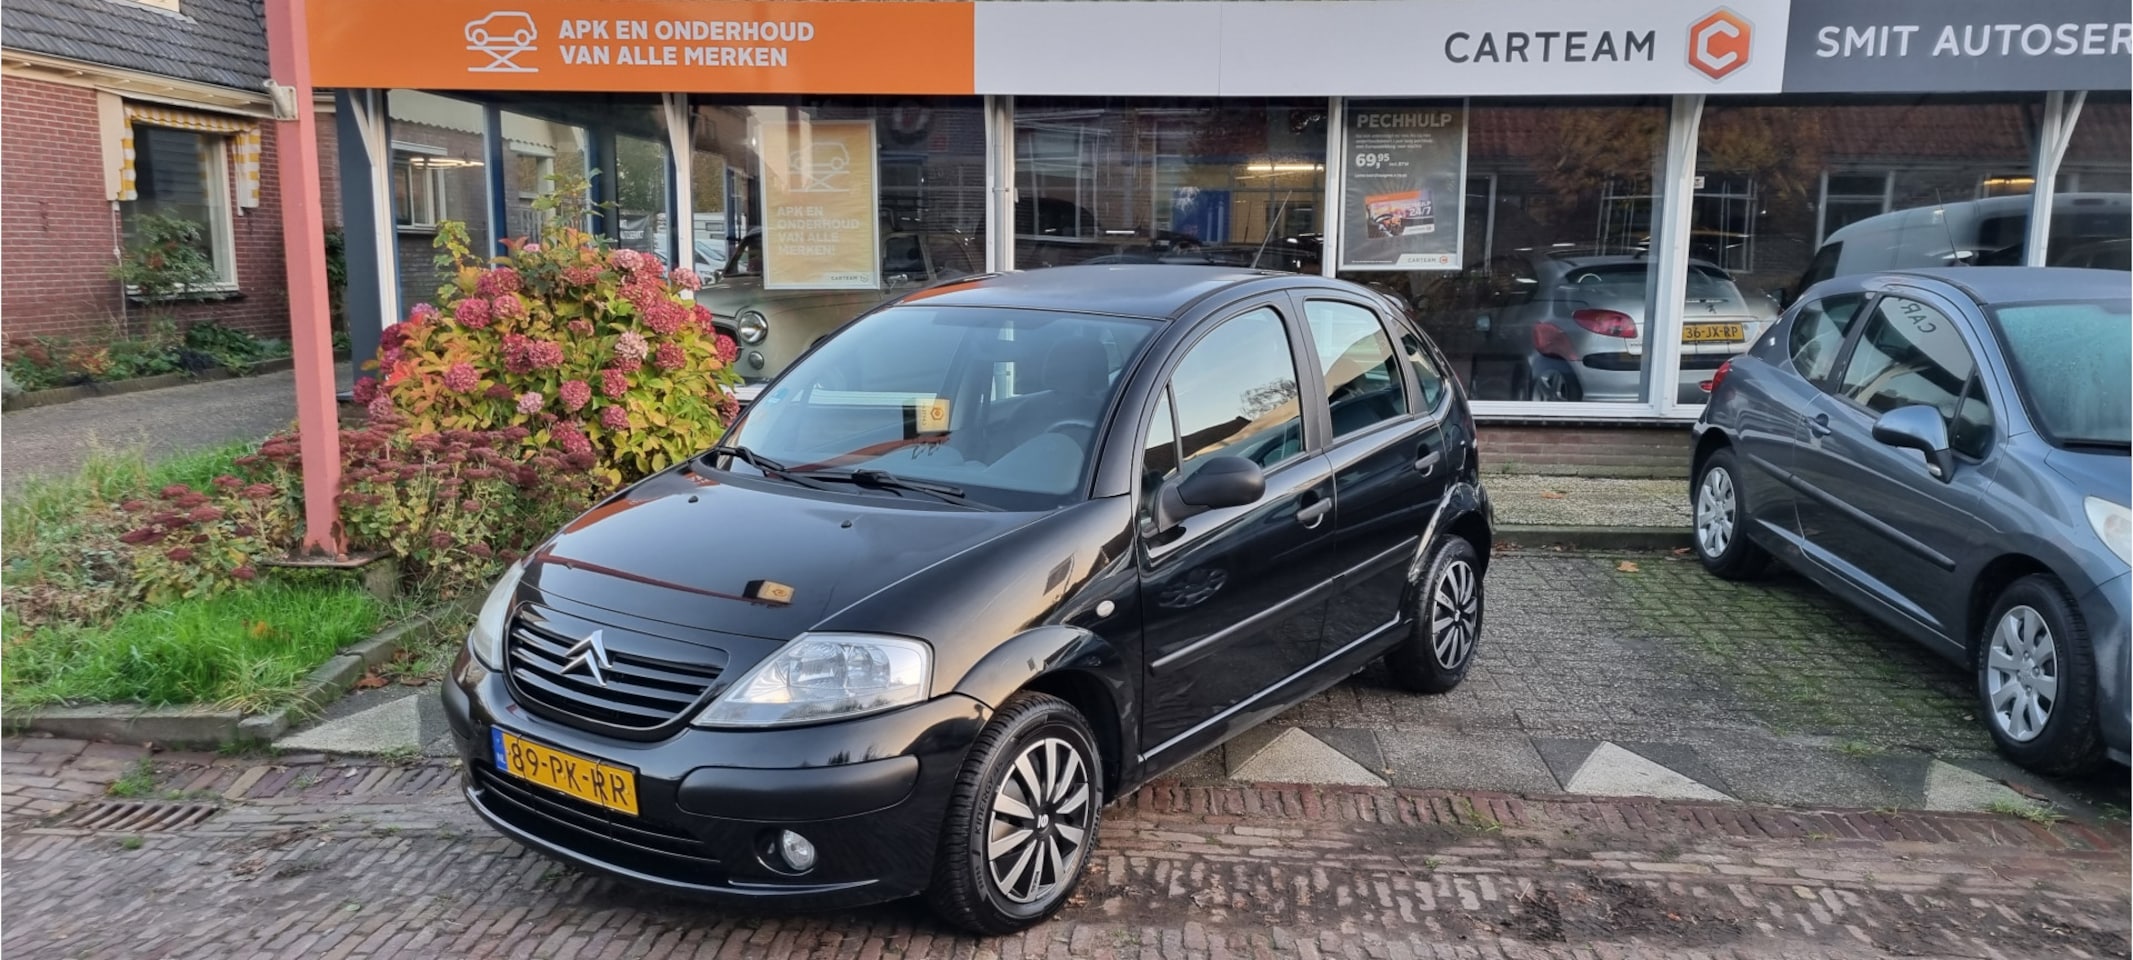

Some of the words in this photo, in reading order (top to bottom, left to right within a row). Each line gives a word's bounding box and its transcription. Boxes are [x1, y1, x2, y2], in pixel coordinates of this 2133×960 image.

[558, 19, 610, 40] APK
[616, 20, 648, 40] EN
[654, 20, 814, 42] ONDERHOUD
[1444, 30, 1656, 63] CARTEAM
[1816, 26, 1919, 57] SMIT
[1932, 23, 2131, 57] AUTOSER
[559, 45, 610, 65] VAN
[616, 46, 678, 66] ALLE
[684, 47, 787, 67] MERKEN
[1356, 113, 1453, 128] PECHHULP
[777, 206, 803, 217] APK
[807, 206, 824, 217] EN
[776, 219, 860, 230] ONDERHOUD
[778, 231, 804, 242] VAN
[807, 232, 840, 242] ALLE
[1685, 326, 1738, 339] 36-JX-RP
[511, 743, 628, 806] 89-PK-RR
